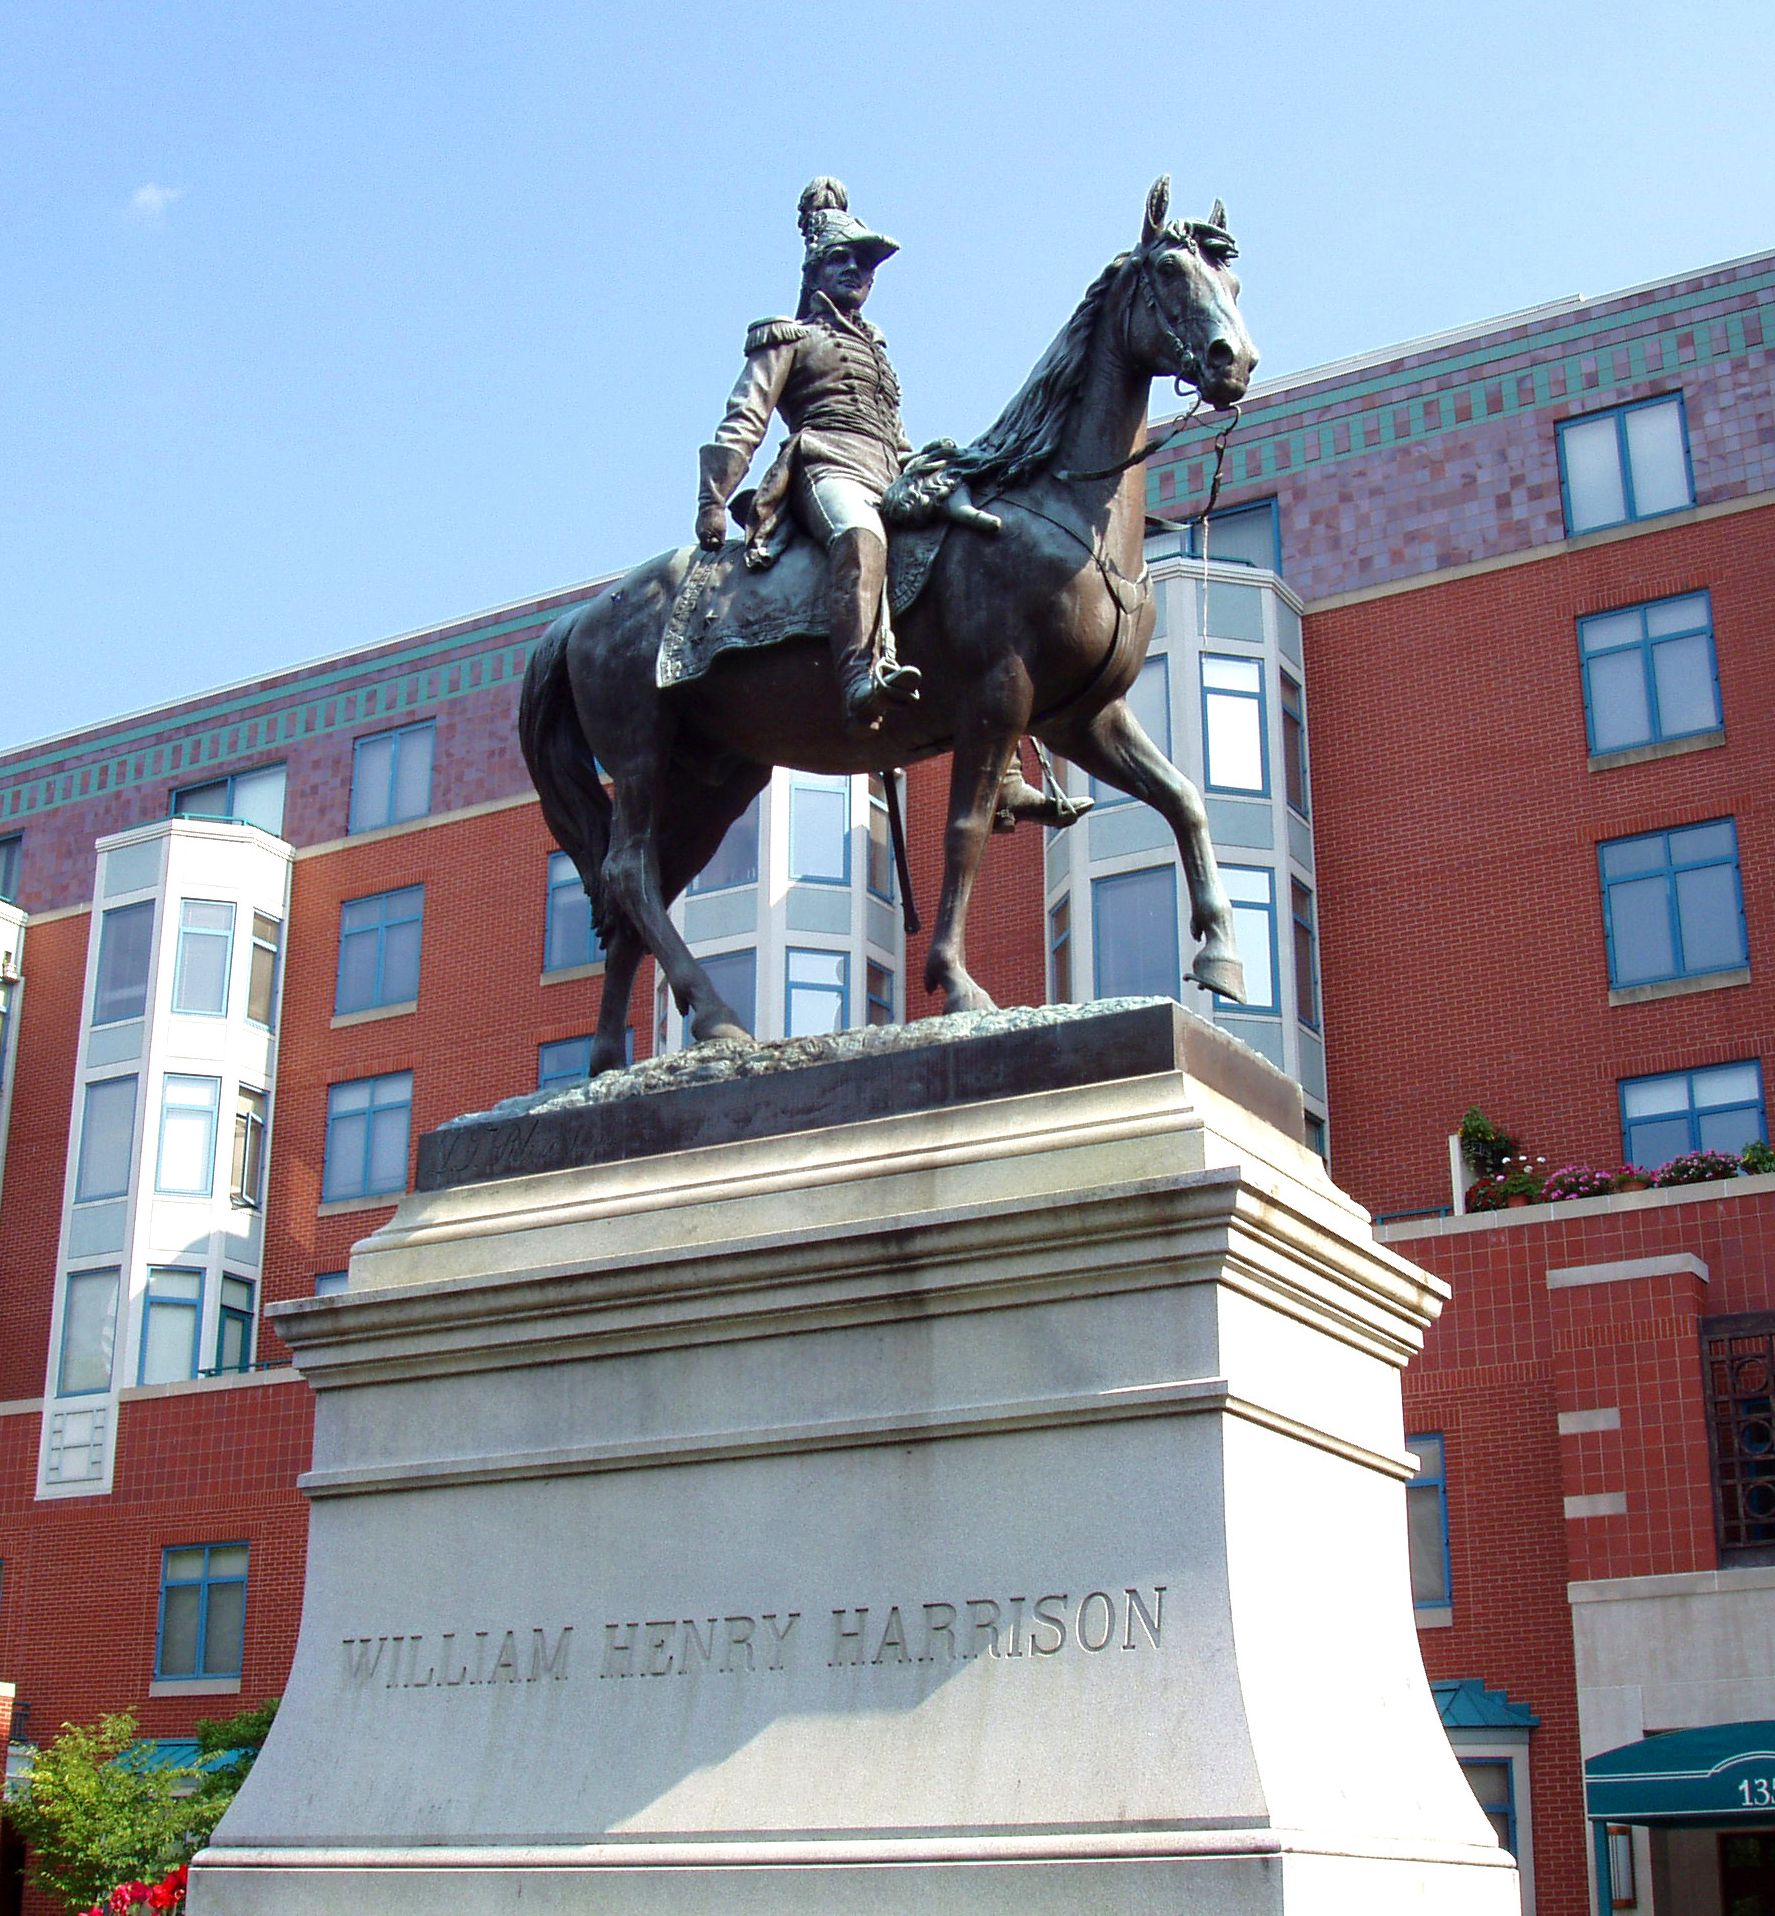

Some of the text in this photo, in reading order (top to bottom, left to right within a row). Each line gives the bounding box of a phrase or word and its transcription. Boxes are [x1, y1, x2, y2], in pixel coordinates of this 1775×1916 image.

[343, 1587, 1167, 1688] WILLIAM HENRY HARRISON
